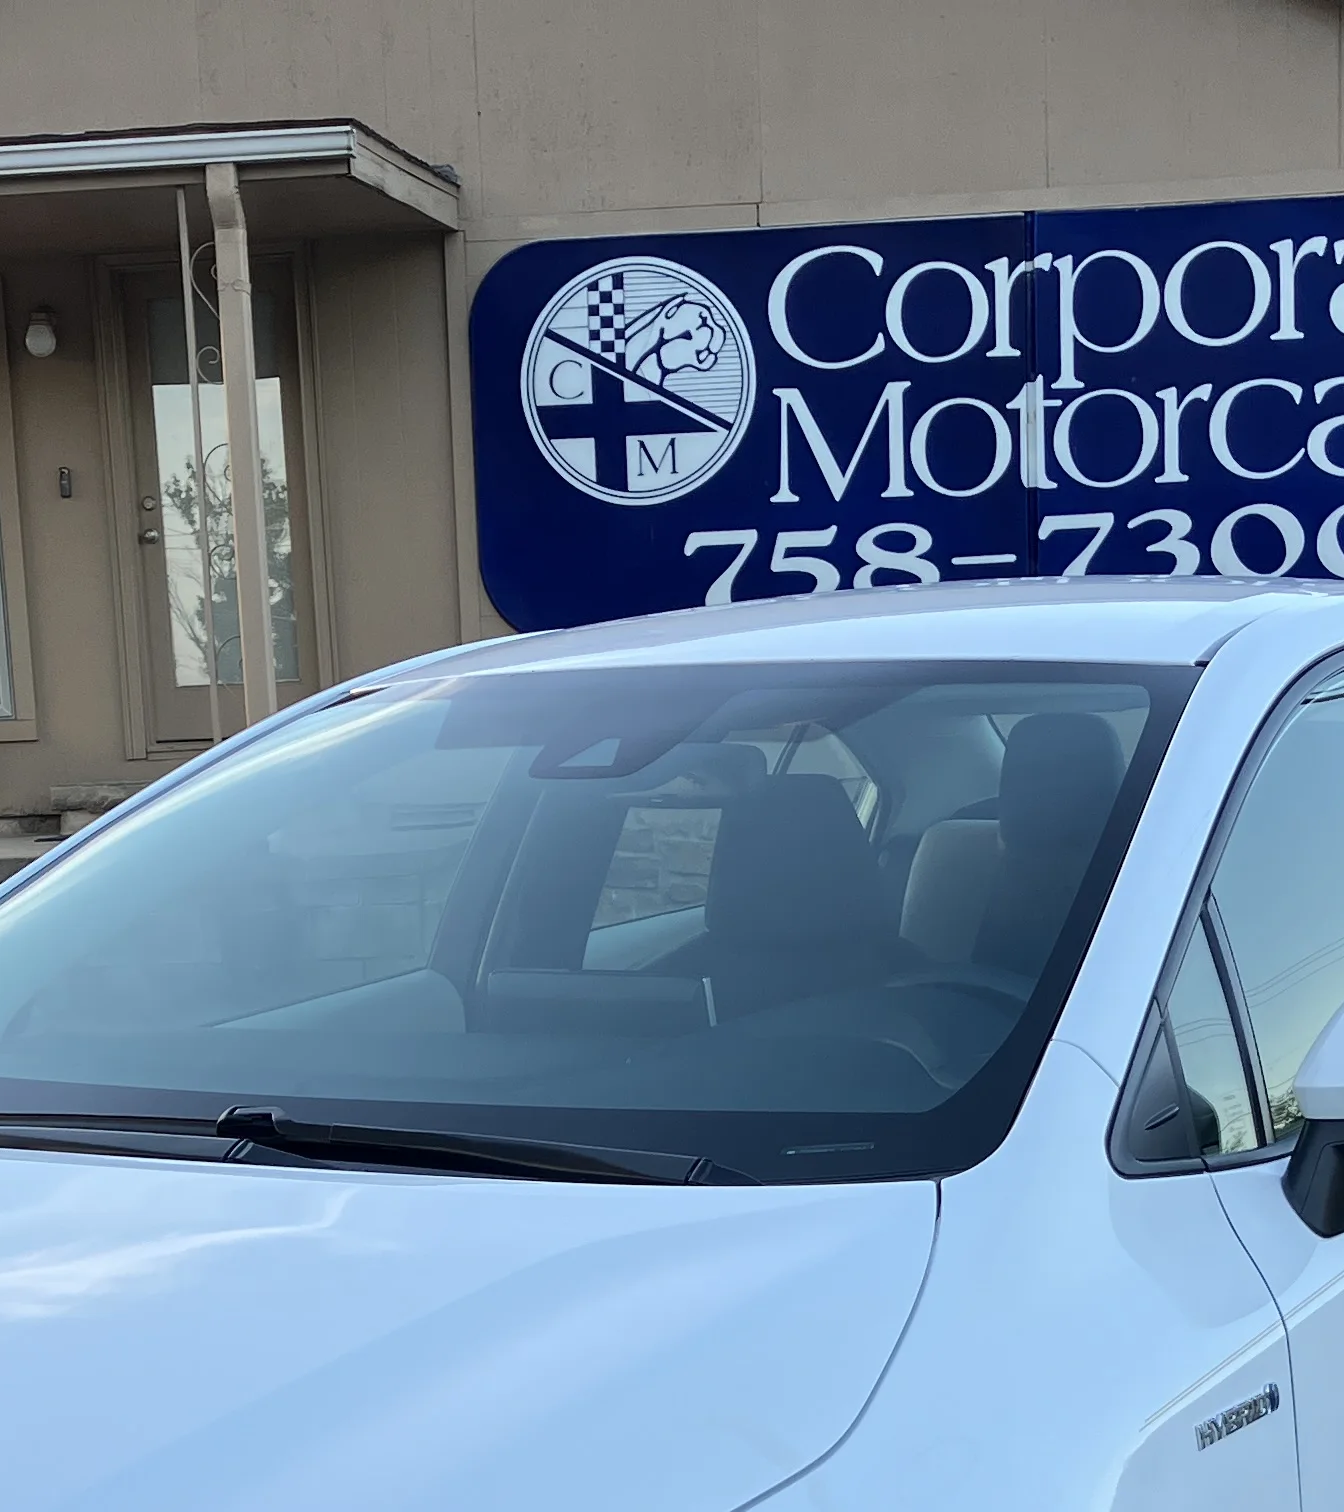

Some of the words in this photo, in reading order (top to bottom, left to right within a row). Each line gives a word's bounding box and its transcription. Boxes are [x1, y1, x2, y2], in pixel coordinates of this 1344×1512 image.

[549, 360, 584, 400] C
[637, 437, 679, 477] M
[1194, 1391, 1275, 1451] HYBRID
